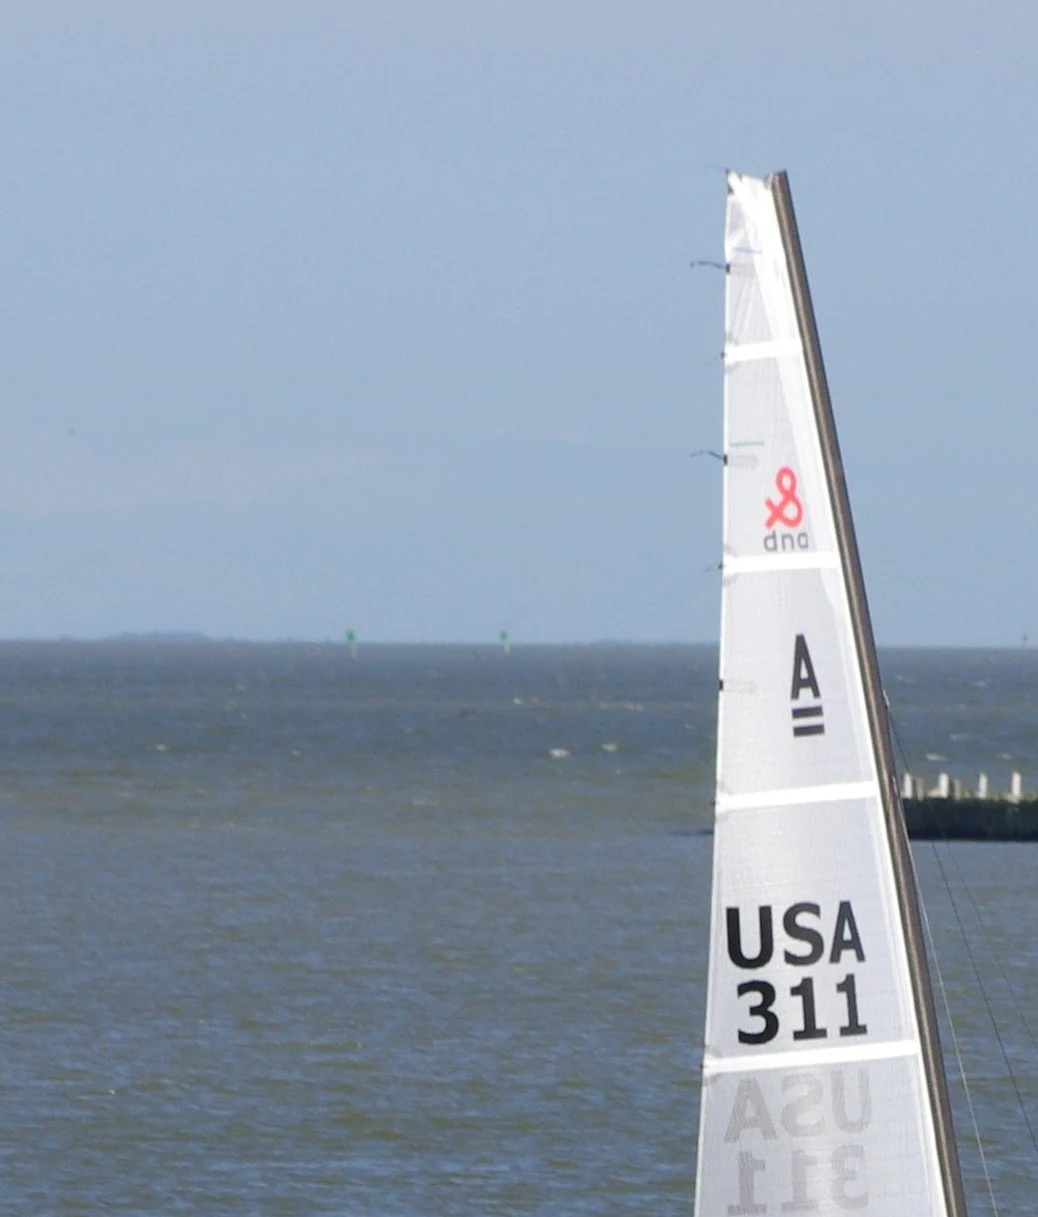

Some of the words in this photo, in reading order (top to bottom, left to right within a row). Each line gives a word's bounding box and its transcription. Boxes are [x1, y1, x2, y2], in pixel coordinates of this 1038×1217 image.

[763, 530, 809, 552] dna
[790, 634, 821, 700] A
[726, 900, 866, 970] USA
[737, 973, 868, 1045] 311
